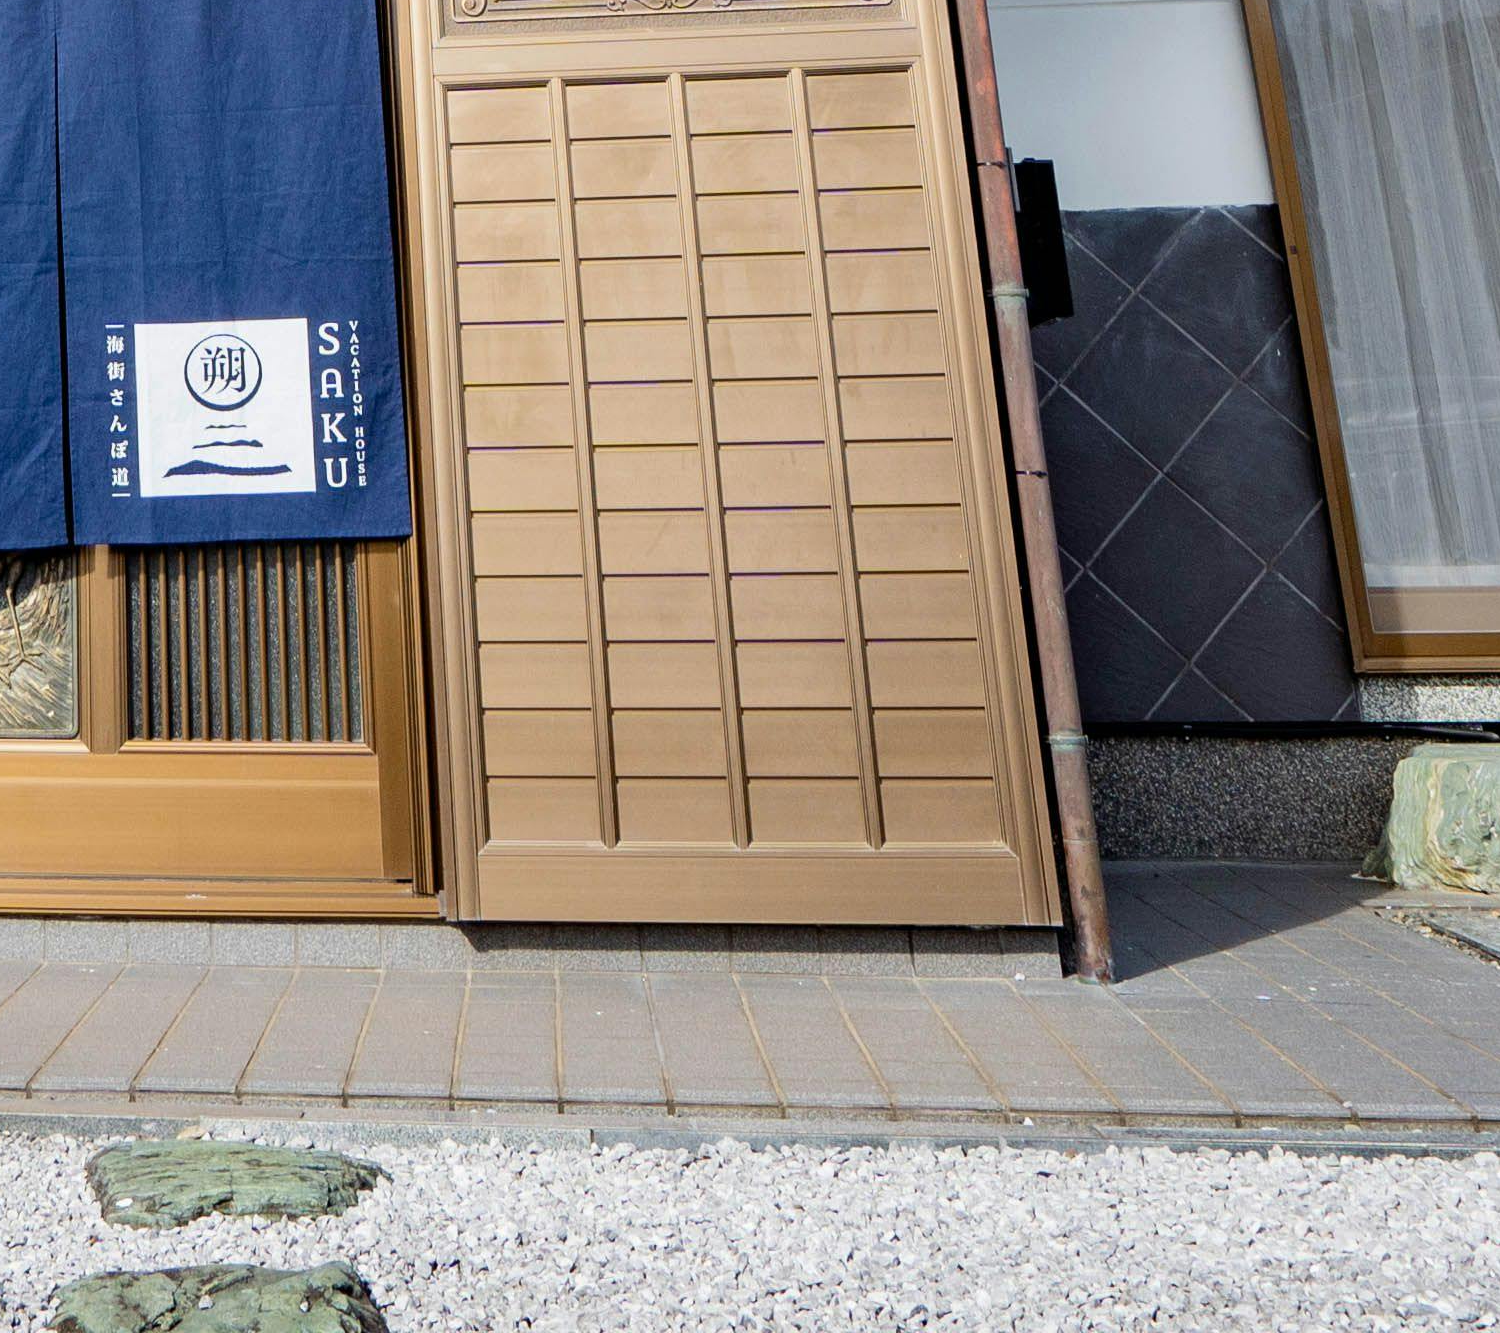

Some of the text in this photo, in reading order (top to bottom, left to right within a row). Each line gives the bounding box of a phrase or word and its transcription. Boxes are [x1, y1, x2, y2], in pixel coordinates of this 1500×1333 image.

[200, 346, 246, 394] 朔
[318, 322, 349, 488] SAKU
[349, 320, 367, 487] VACATION HOUSE
